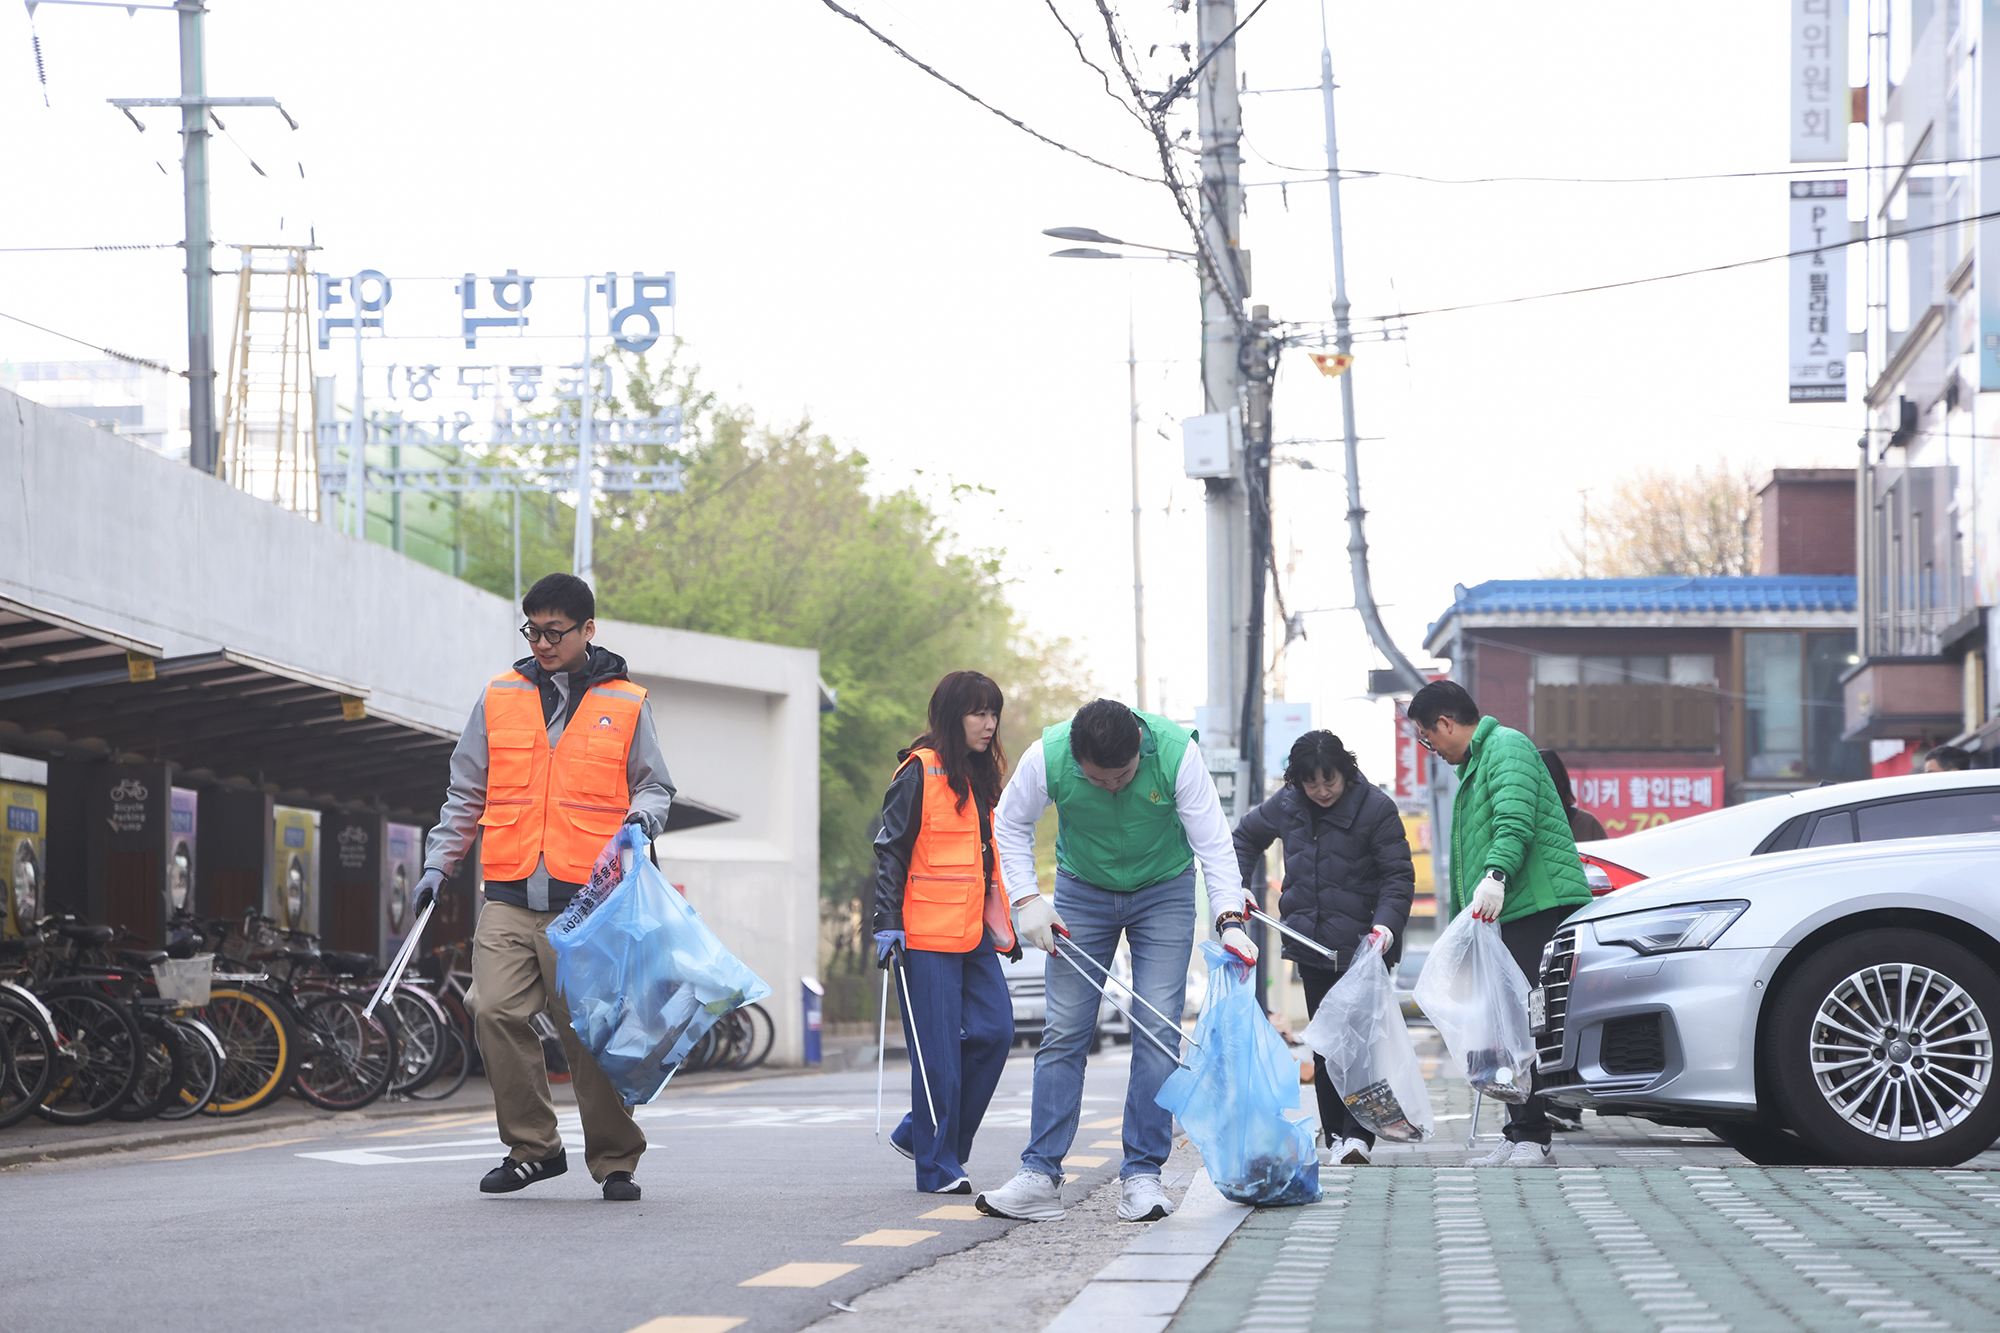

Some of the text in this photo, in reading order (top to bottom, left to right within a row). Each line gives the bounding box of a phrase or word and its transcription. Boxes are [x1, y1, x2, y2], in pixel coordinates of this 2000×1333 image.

[1629, 776, 1713, 808] 할인판매
[114, 803, 144, 813] Bicycle
[113, 813, 146, 823] Parking
